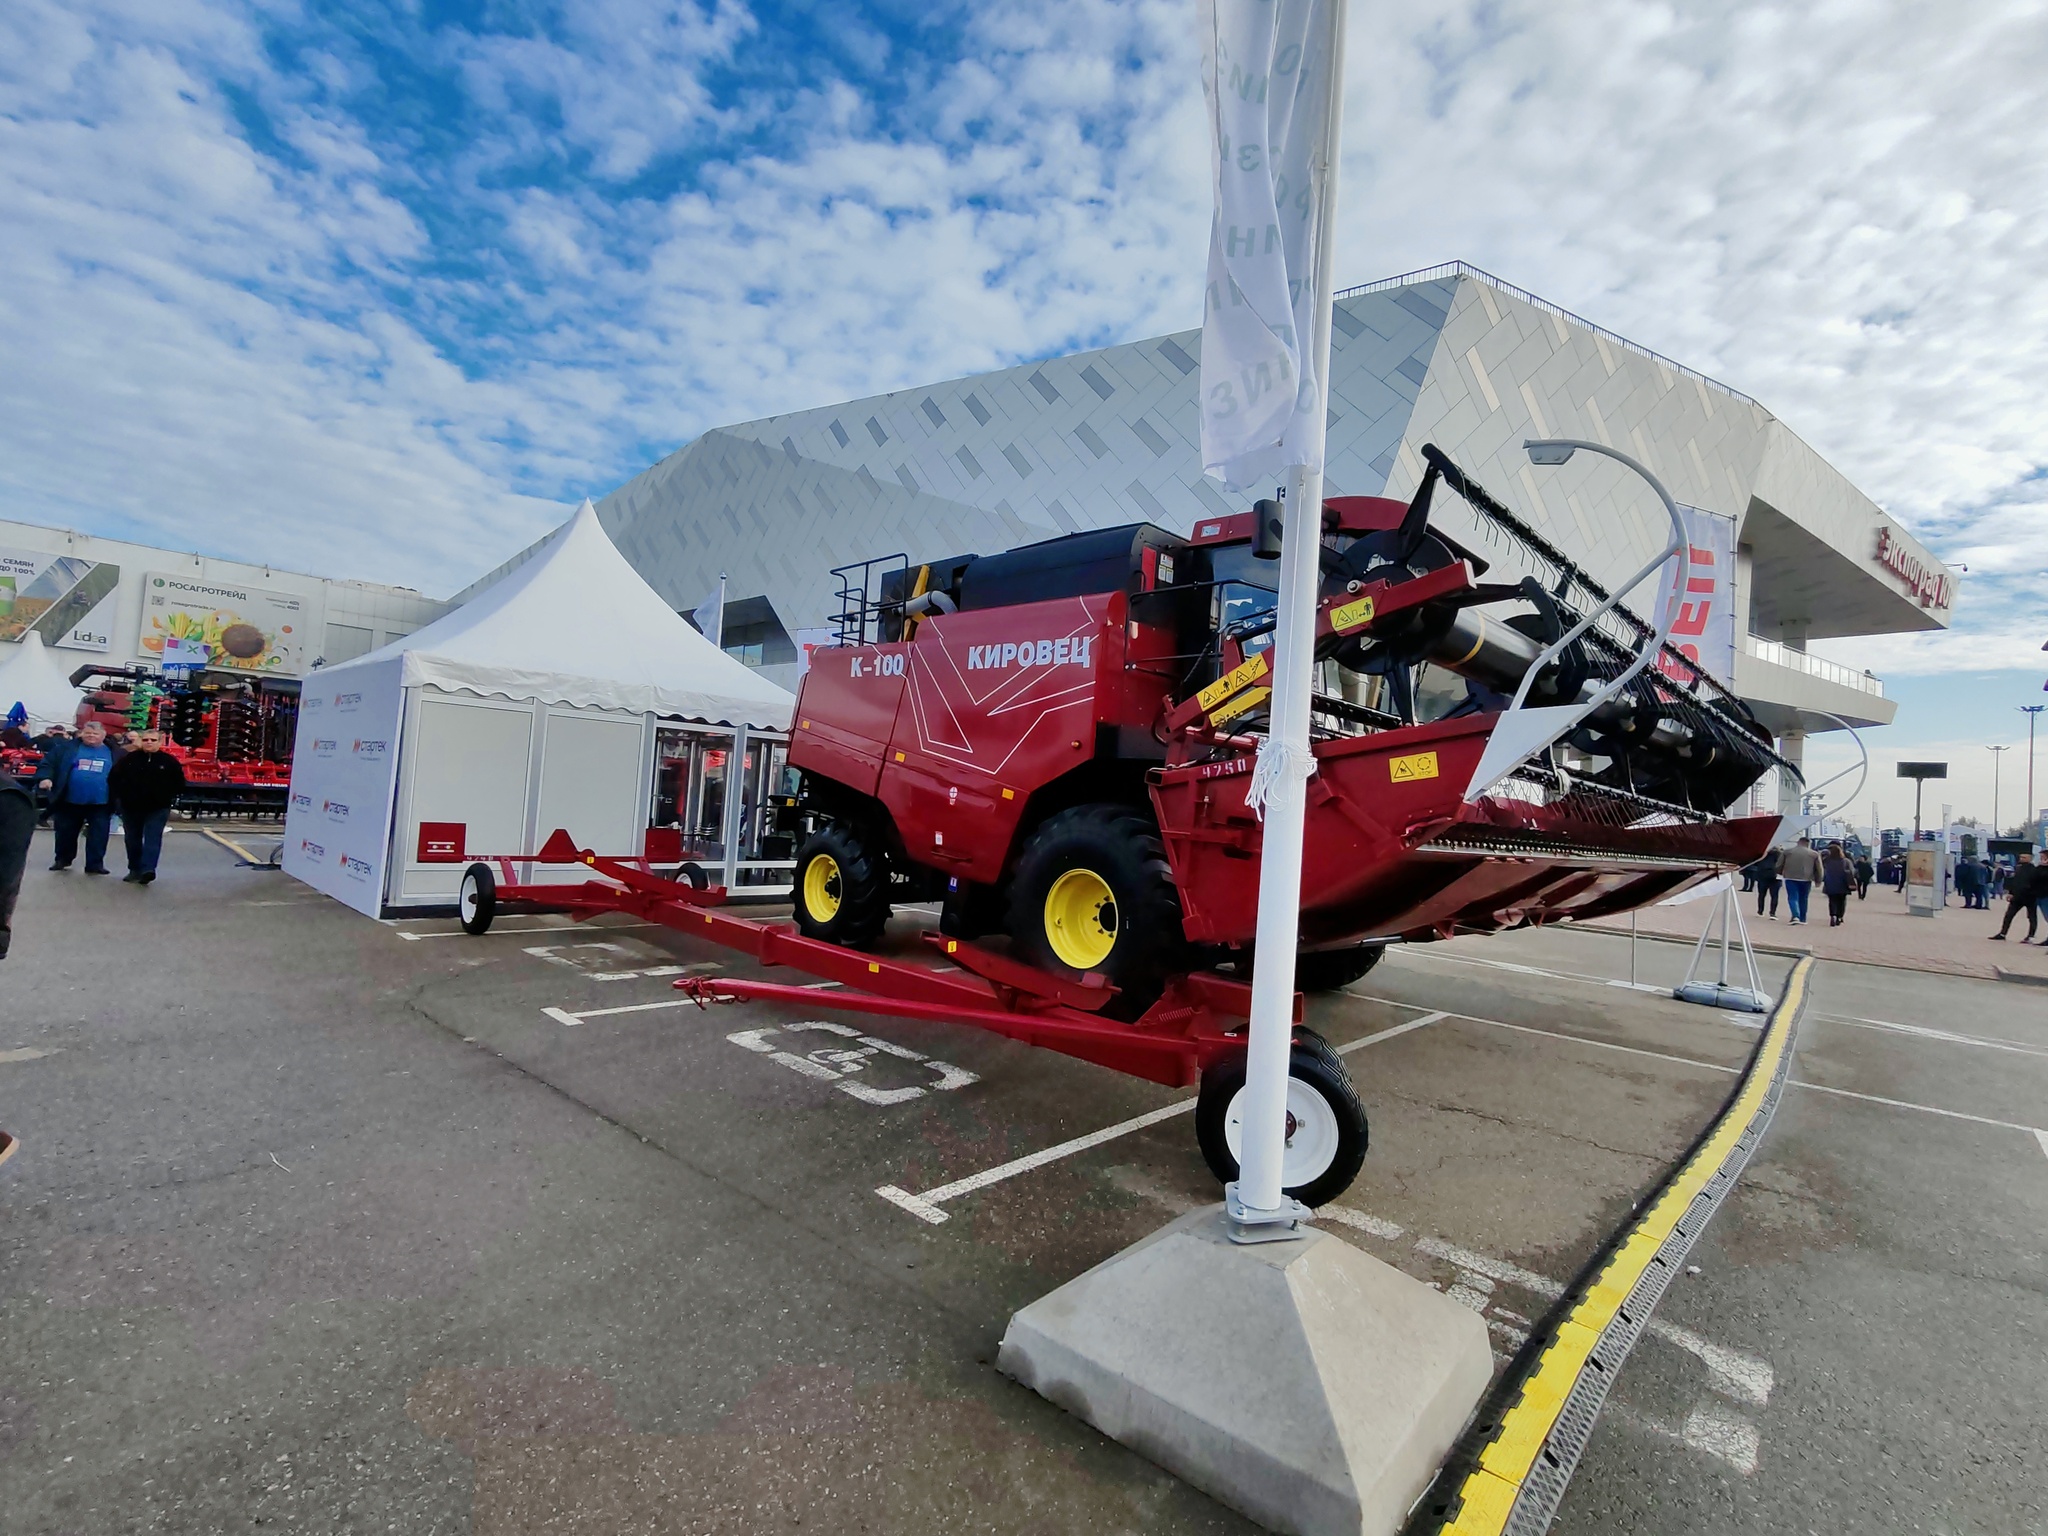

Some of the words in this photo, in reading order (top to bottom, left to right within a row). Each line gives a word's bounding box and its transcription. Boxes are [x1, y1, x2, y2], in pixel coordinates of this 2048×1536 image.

[3, 558, 34, 568] СЕМЯН
[14, 568, 36, 576] 100%
[168, 581, 247, 601] РОСАГРОТРЕЙД
[74, 630, 107, 644] Lidea
[967, 635, 1090, 670] КИРОВЕЦ
[850, 653, 905, 678] К-100
